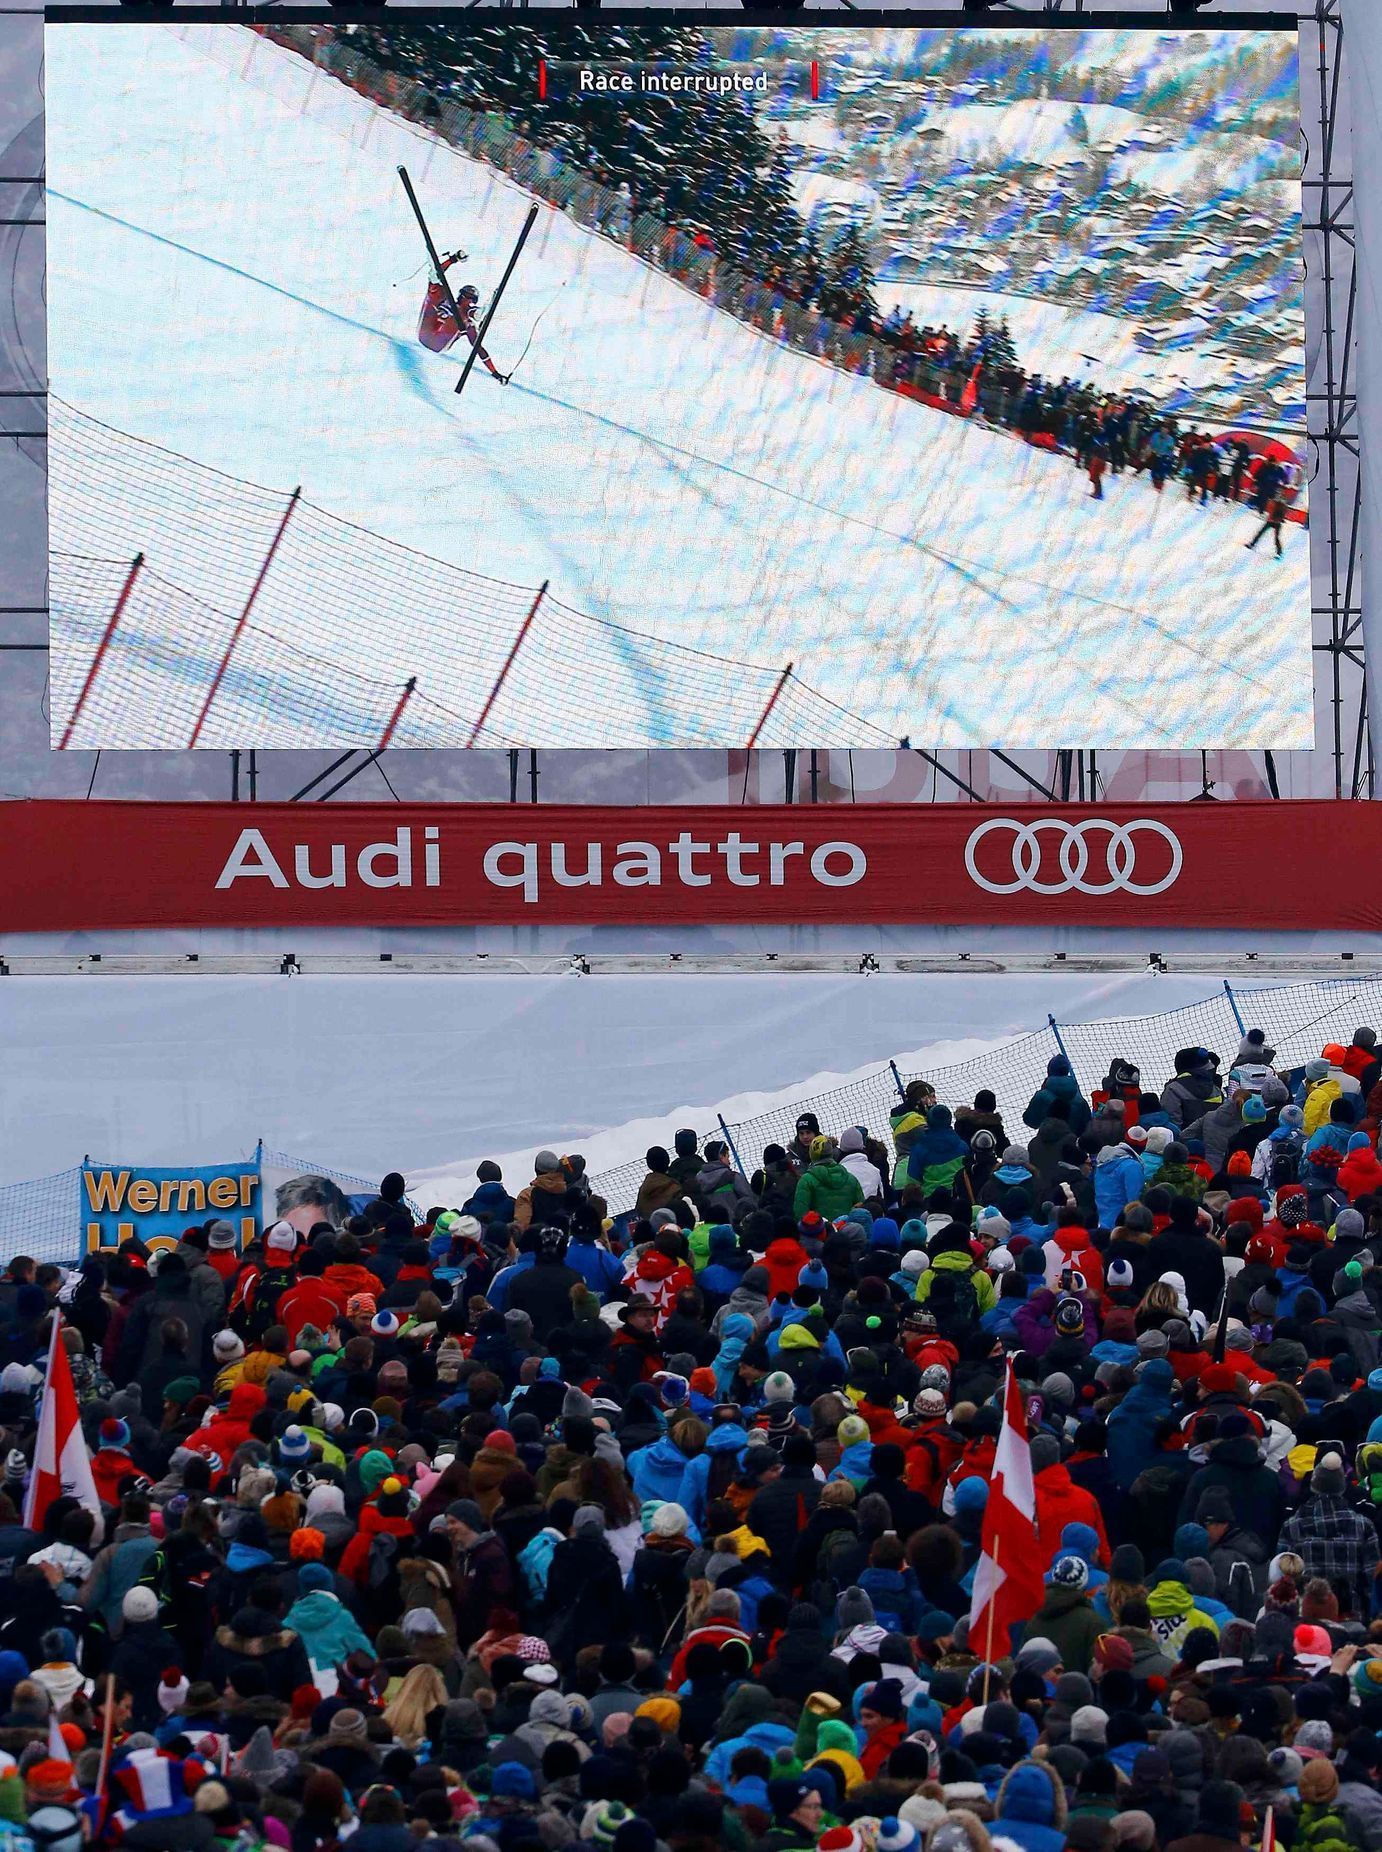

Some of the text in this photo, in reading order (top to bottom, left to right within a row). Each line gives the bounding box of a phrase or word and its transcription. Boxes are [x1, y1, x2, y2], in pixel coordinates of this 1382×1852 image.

[579, 70, 769, 96] Race interrupted
[216, 827, 867, 903] Audi quattro
[83, 1170, 259, 1213] Werner
